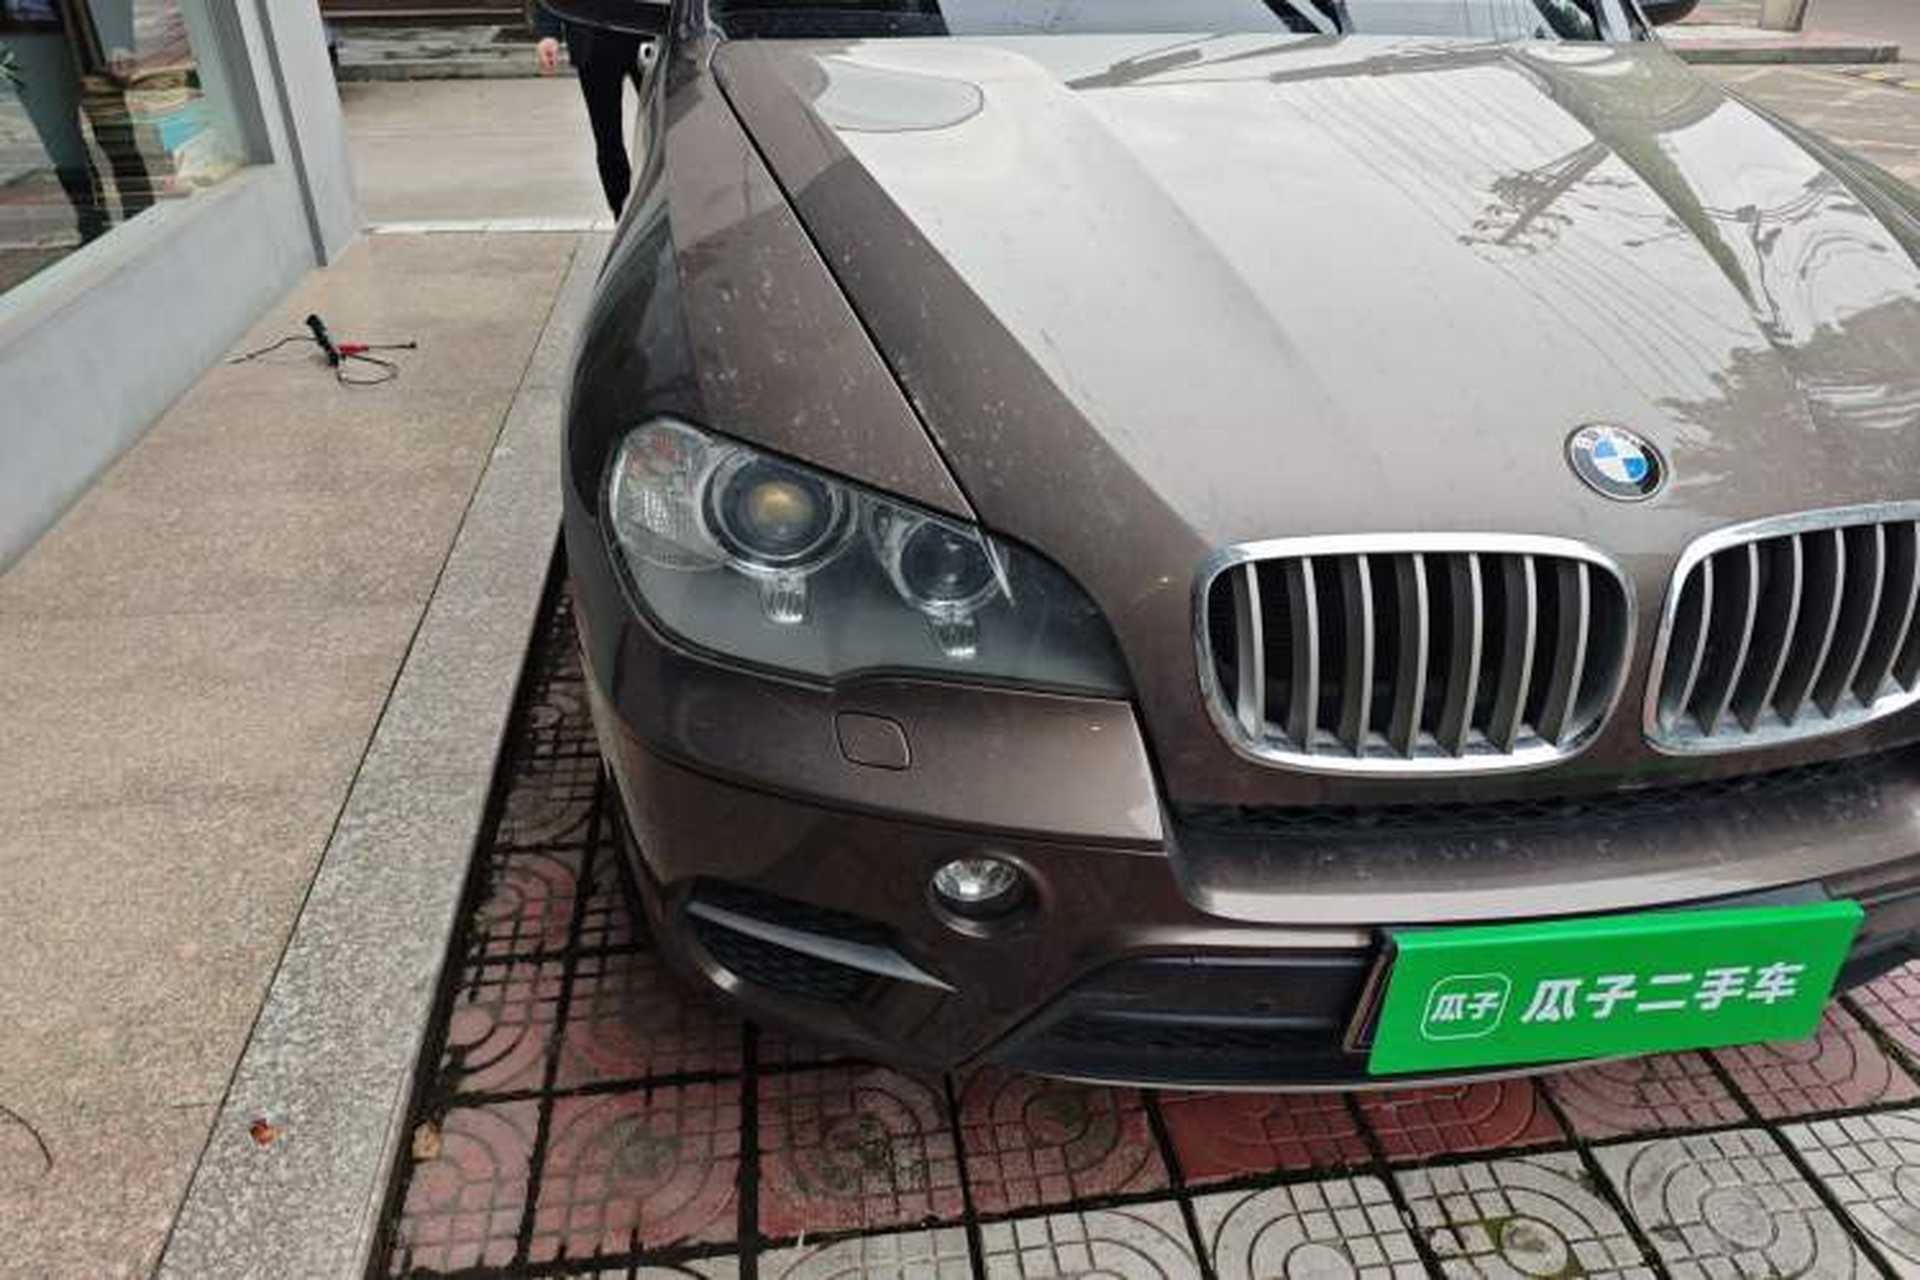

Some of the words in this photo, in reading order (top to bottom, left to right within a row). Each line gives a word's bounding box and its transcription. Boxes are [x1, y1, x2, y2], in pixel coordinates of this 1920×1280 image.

[1430, 991, 1499, 1021] 瓜子
[1520, 962, 1804, 1023] 瓜子二手车
